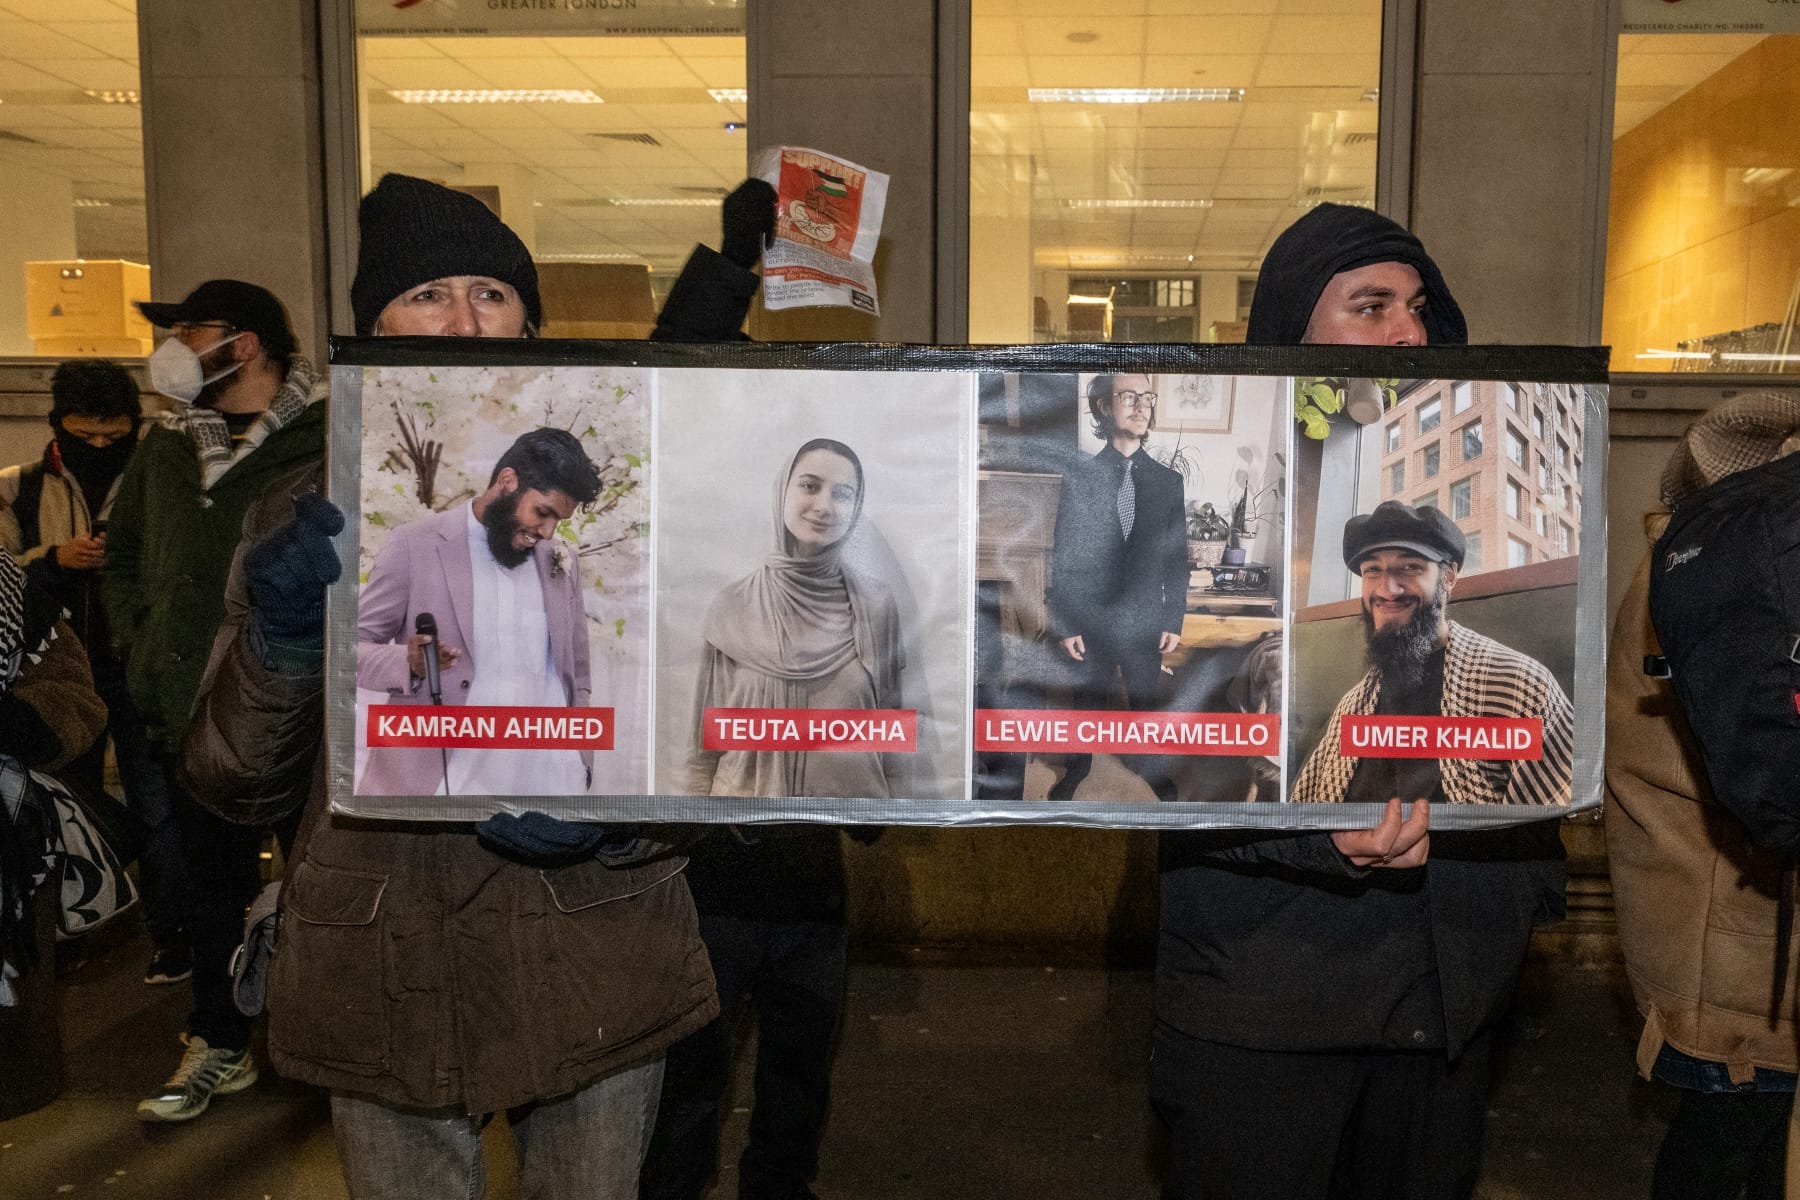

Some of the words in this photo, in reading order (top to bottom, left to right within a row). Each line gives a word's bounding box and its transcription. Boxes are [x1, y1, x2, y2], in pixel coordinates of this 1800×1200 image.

[487, 0, 557, 9] GREATER
[378, 715, 495, 738] KAMRAN
[503, 717, 603, 740] AHMED
[715, 718, 800, 741] TEUTA
[809, 719, 906, 742] HOXHA
[985, 719, 1069, 743] LEWIE
[1077, 720, 1269, 746] CHIARAMELLO
[1351, 725, 1428, 748] UMER
[1436, 727, 1532, 750] KHALID
